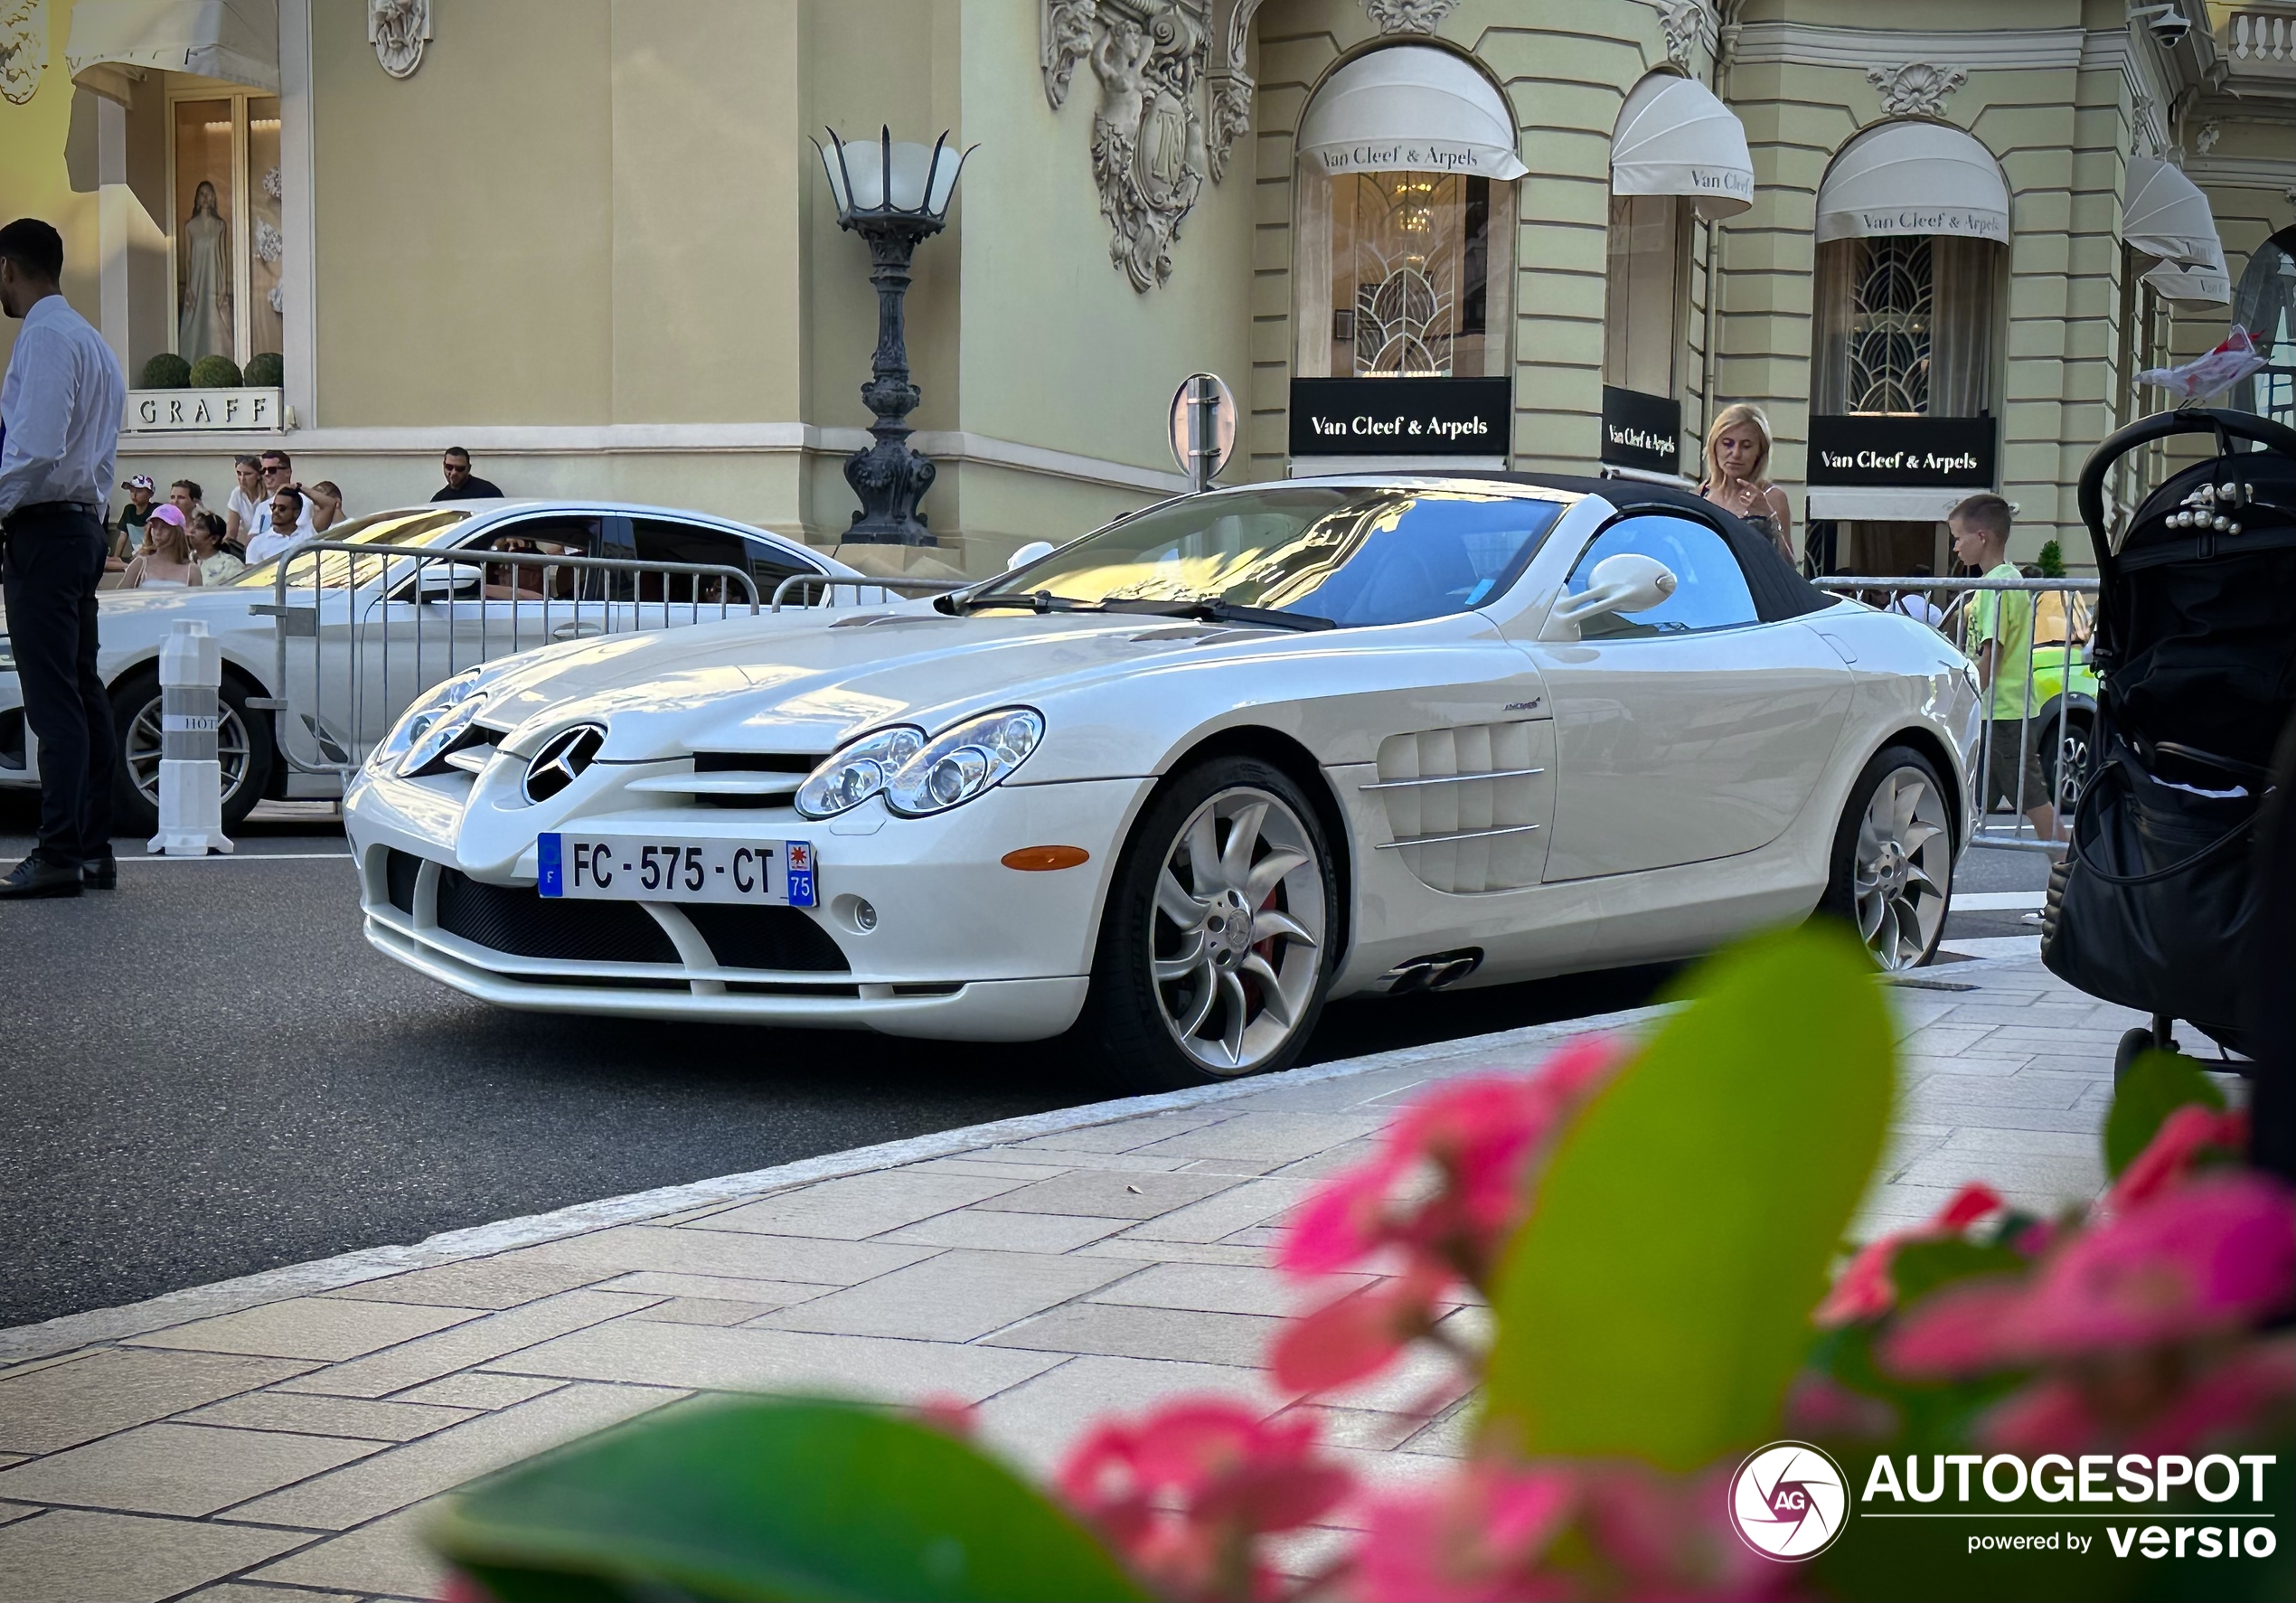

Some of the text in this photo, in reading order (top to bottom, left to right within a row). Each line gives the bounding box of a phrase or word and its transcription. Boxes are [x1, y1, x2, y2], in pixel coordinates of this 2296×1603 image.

[1323, 145, 1478, 169] Van Cleef & Arpels
[1691, 169, 1719, 188] Van
[1863, 213, 1893, 229] Van
[1899, 212, 1945, 228] Cleef
[1949, 217, 1960, 229] &
[139, 399, 266, 423] GRAFF
[1312, 416, 1488, 440] Van Cleef & Arpels
[1821, 451, 1977, 474] Van Cleef & Arpels
[547, 872, 553, 882] F
[791, 877, 810, 896] 75
